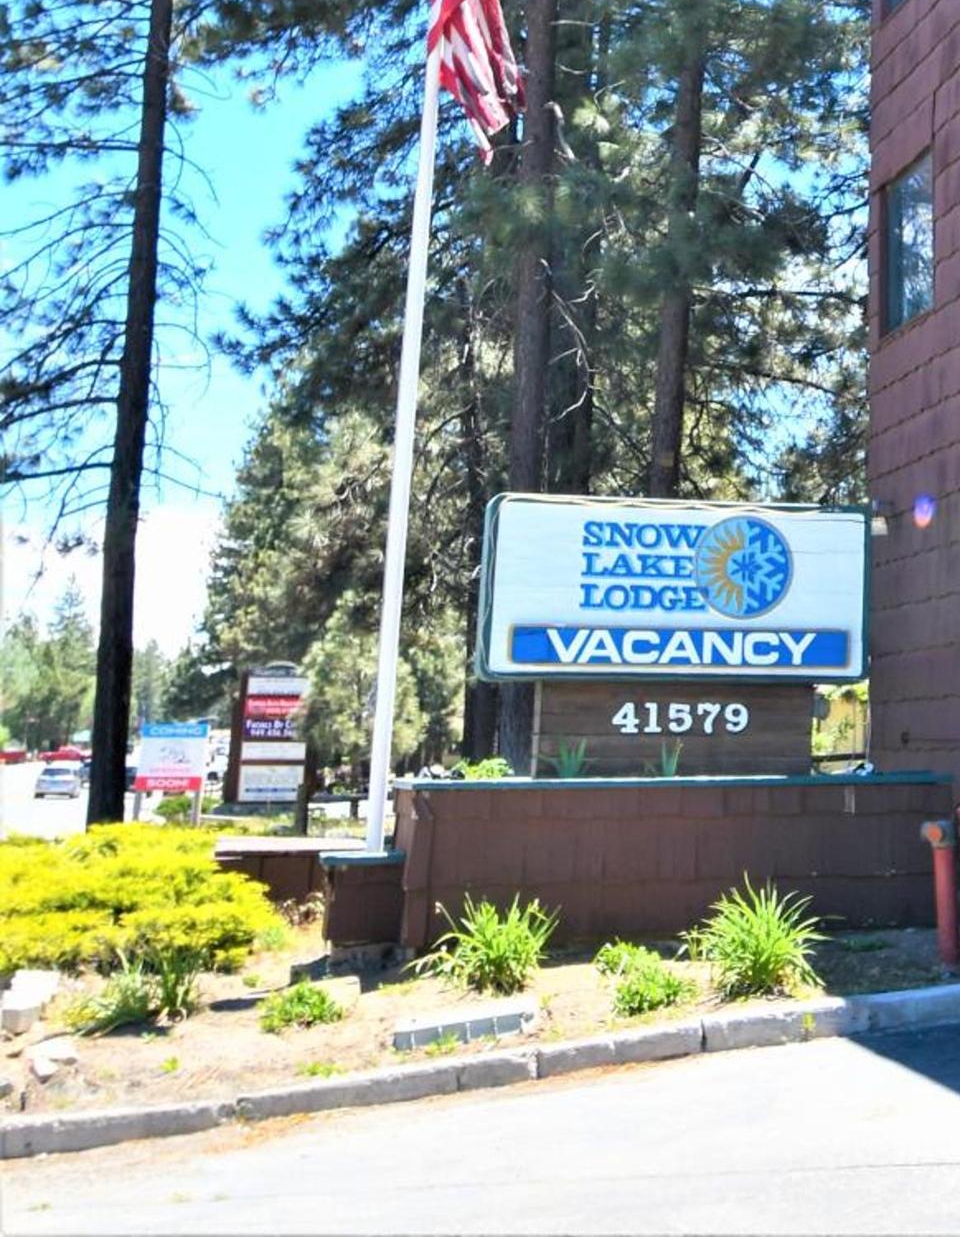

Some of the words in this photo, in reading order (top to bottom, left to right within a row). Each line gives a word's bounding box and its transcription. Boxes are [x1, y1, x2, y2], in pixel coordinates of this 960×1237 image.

[583, 521, 707, 548] SNOW
[581, 552, 694, 578] LAKE
[579, 583, 710, 611] LODGE
[547, 628, 816, 666] VACANCY
[150, 726, 202, 736] COMING
[611, 702, 749, 734] 41579
